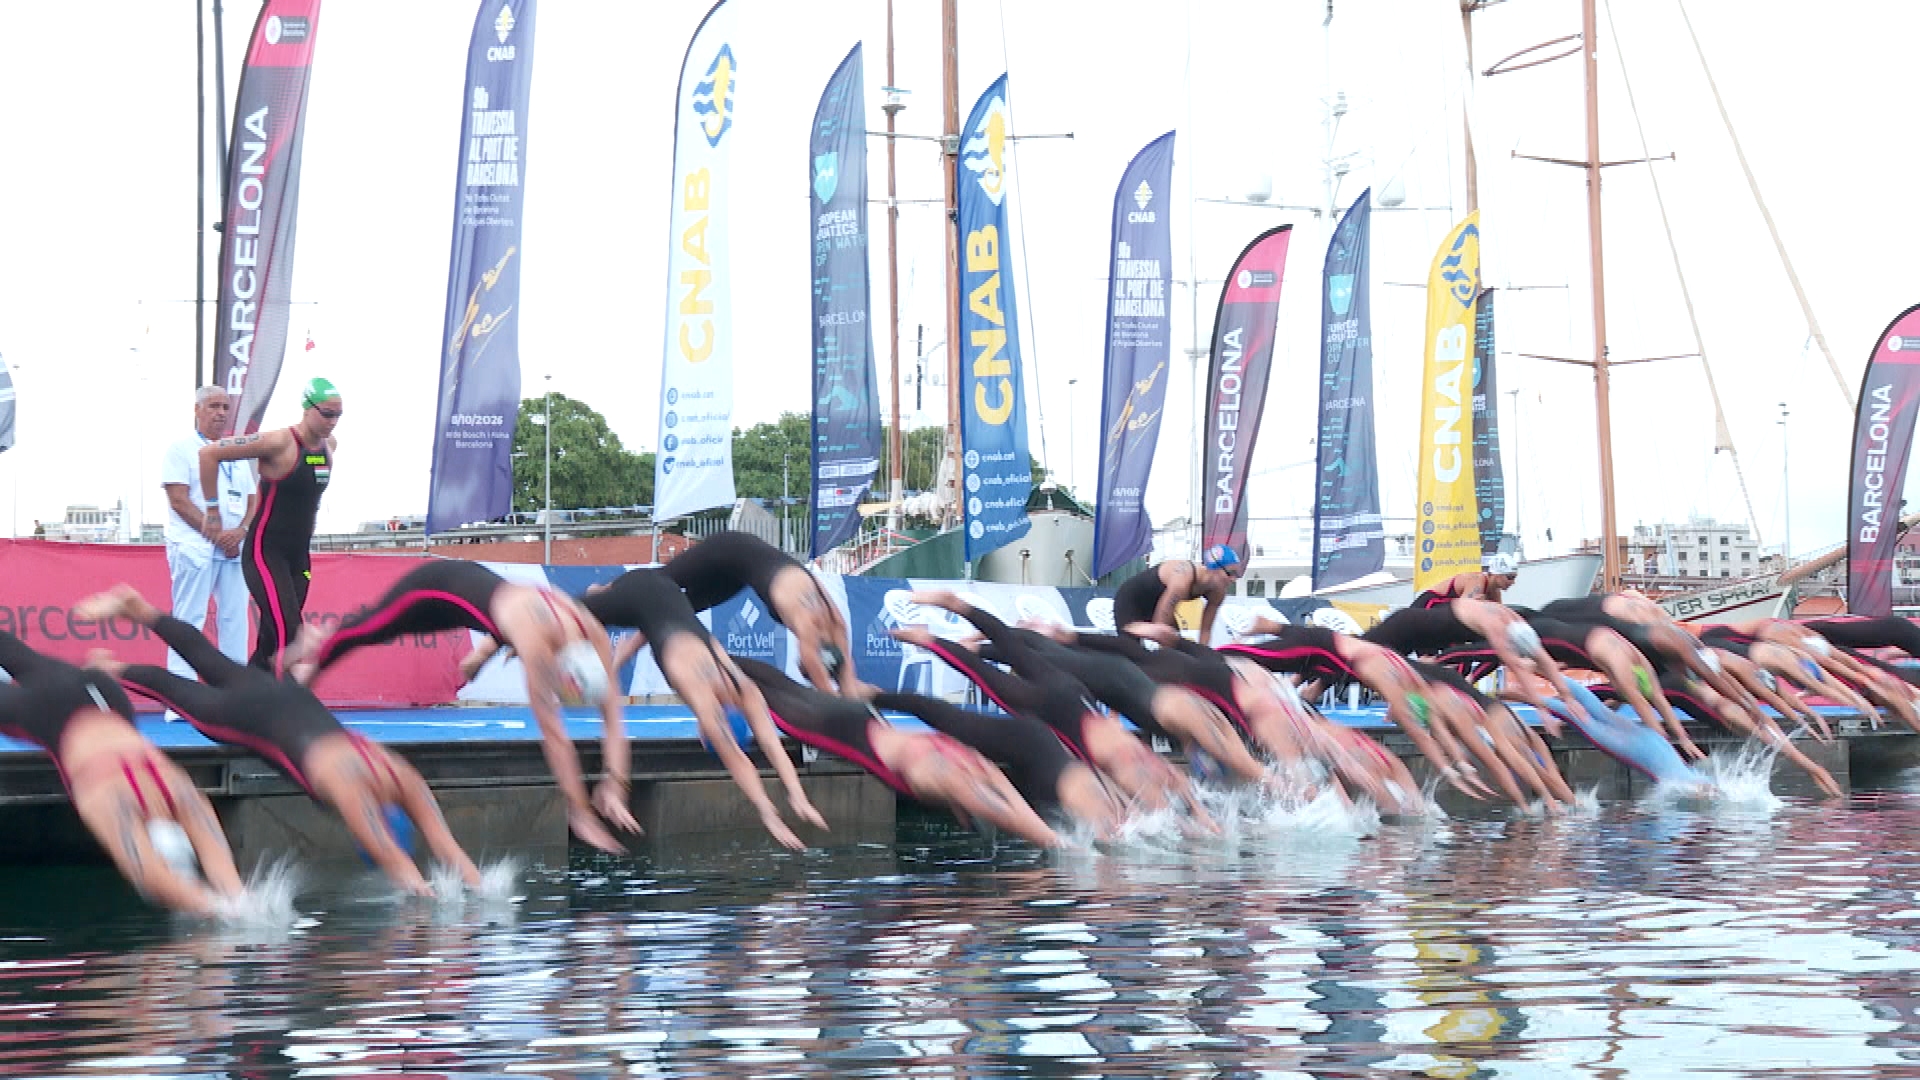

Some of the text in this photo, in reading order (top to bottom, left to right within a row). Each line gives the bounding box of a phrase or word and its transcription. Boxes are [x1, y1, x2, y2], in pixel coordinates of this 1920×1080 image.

[487, 46, 515, 62] CNAB
[466, 162, 519, 186] BARCELONA
[1127, 211, 1156, 223] CNAB
[227, 106, 269, 395] BARCELONA
[679, 167, 715, 363] CNAB
[1149, 279, 1164, 299] DE
[1114, 299, 1165, 317] BARCELONA
[966, 224, 1014, 425] CNAB
[1433, 324, 1466, 482] CNAB
[1215, 327, 1243, 514] BARCELONA
[1860, 384, 1893, 543] BARCELONA
[1662, 580, 1770, 617] VER SPRAY
[728, 631, 775, 649] Port Vell
[867, 633, 890, 649] Port
